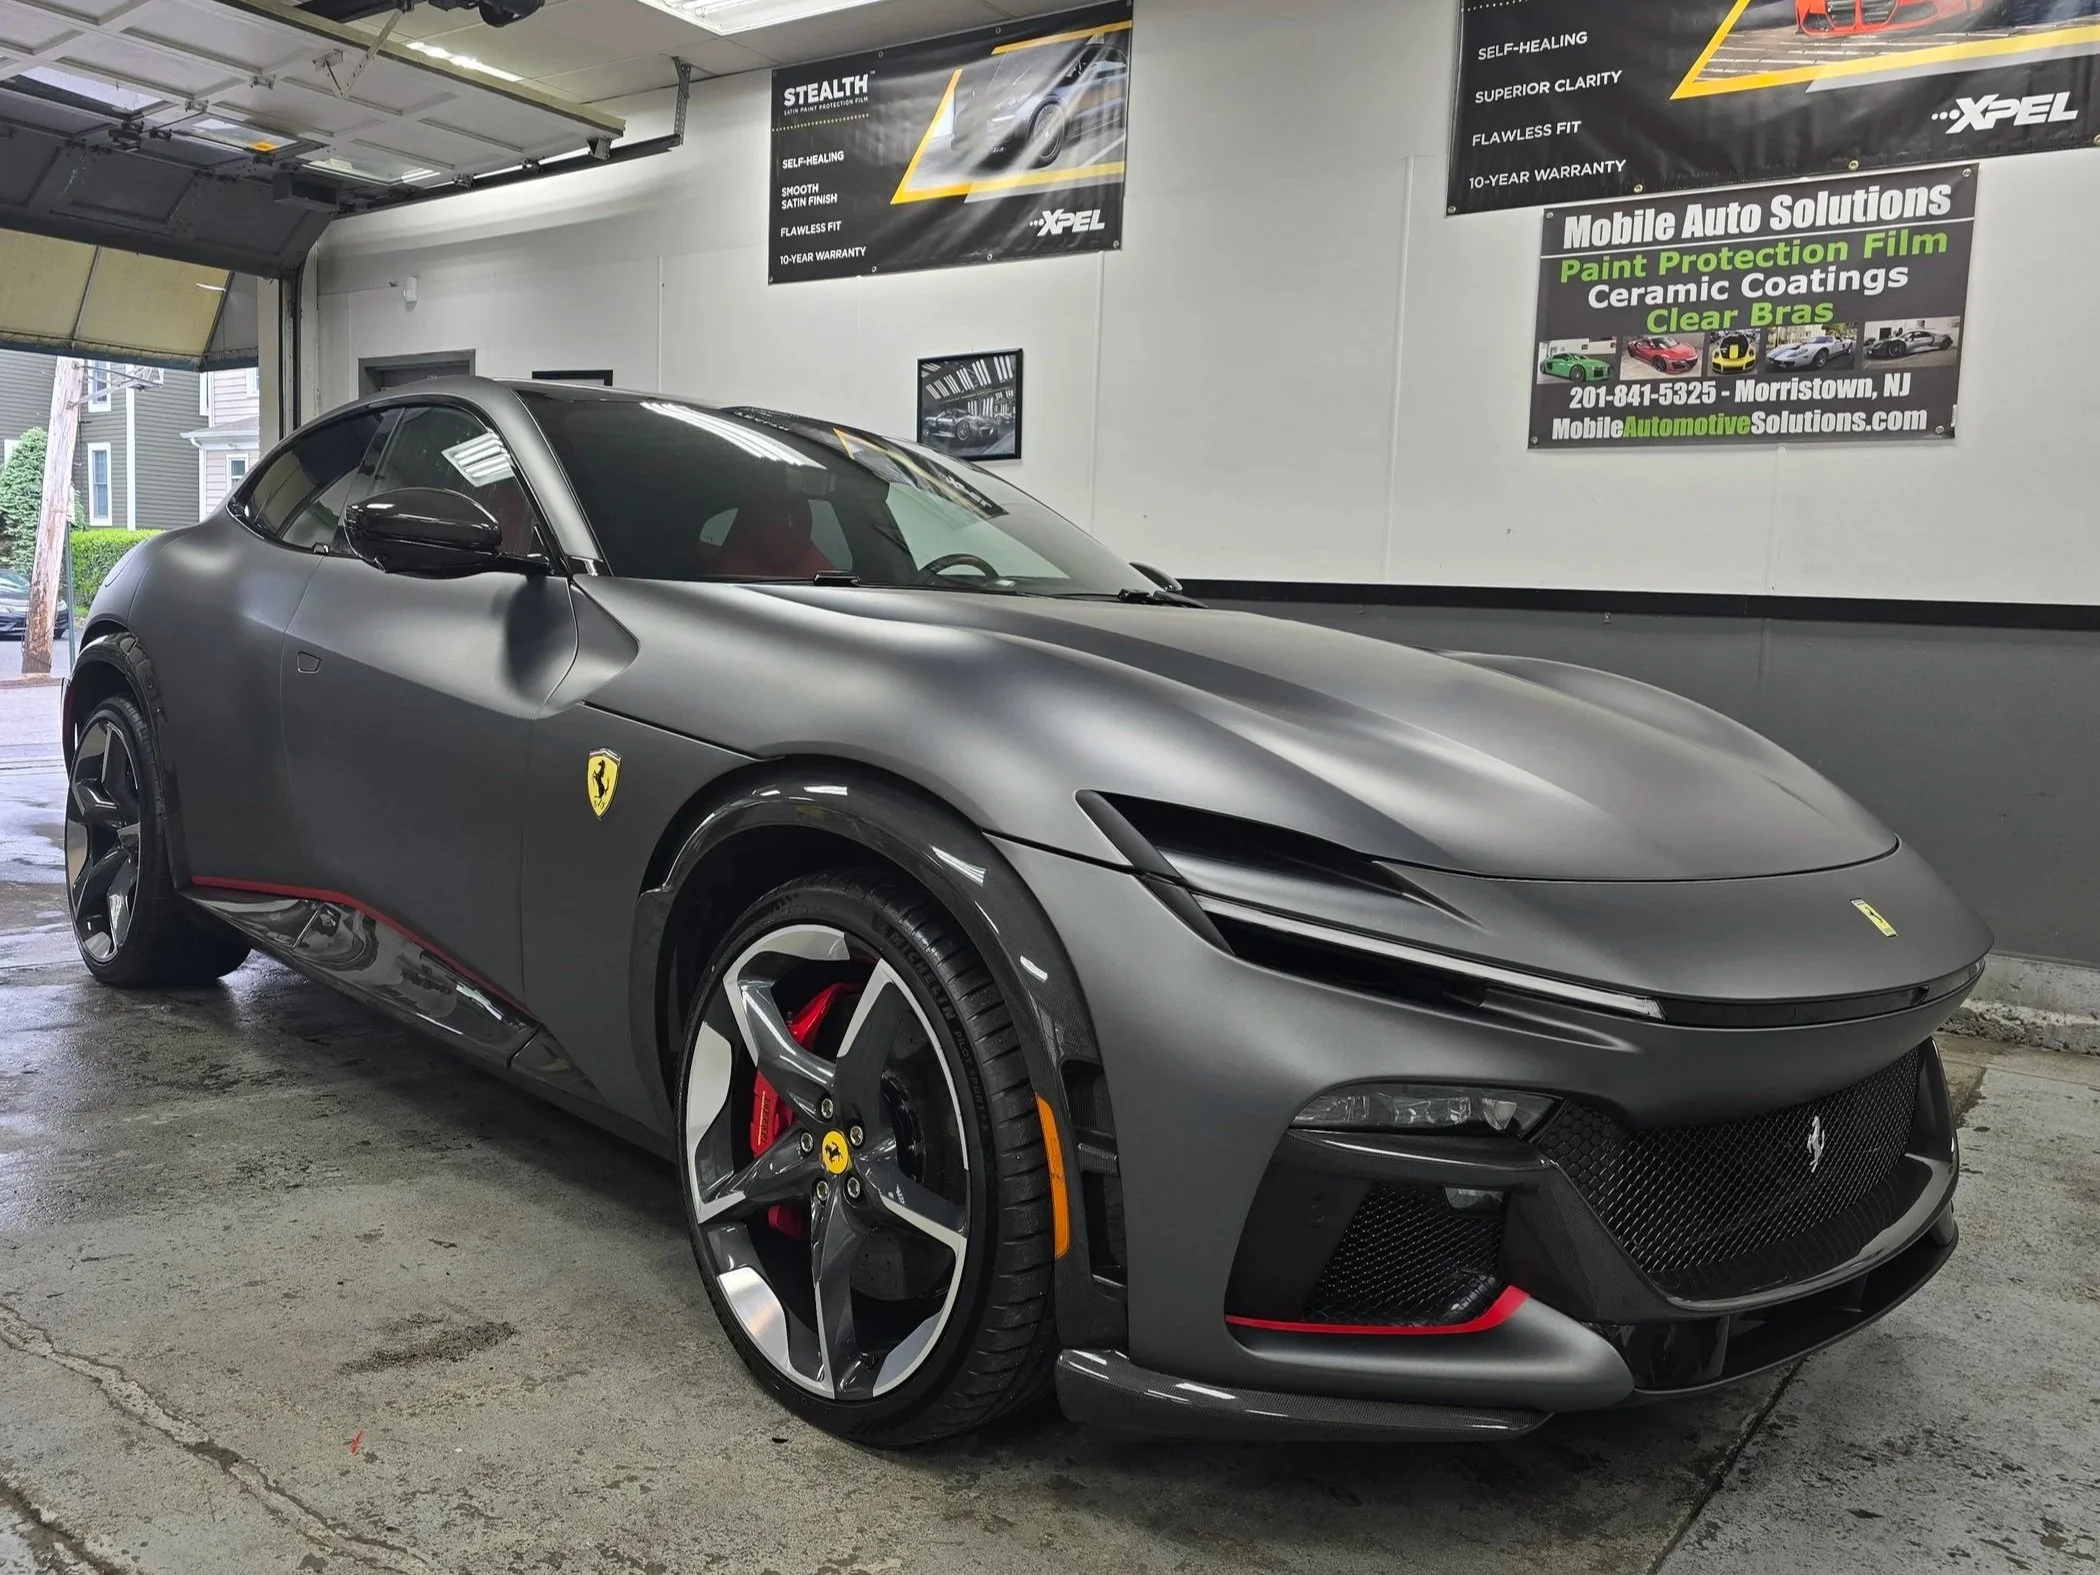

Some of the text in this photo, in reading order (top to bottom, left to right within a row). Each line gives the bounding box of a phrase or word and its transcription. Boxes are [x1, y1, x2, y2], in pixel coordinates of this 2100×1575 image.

[1478, 31, 1588, 60] SELF-HEALING
[784, 74, 868, 107] STEALTH
[1475, 69, 1622, 104] SUPERIOR CLARITY
[819, 99, 853, 110] PROTECTION
[1945, 91, 2079, 134] XPEL
[1472, 121, 1582, 147] FLAWLESS FIT
[782, 150, 844, 169] SELF-HEALING
[1469, 159, 1627, 189] 10-YEAR WARRANTY
[781, 183, 819, 197] SMOOTH
[781, 193, 838, 210] SATIN FINISH
[780, 220, 842, 238] FLAWLESS FIT
[1036, 208, 1106, 237] XPEL
[1563, 184, 1952, 249] Mobile Auto Solutions
[780, 246, 867, 265] 10-YEAR WARRANTY
[1560, 228, 1948, 284] Paint Protection Film
[1588, 265, 1909, 309] Ceramic Coatings
[1646, 302, 1834, 333] Clear Bras
[1569, 380, 1716, 409] 201-841-5325
[1734, 376, 1878, 403] Morristown,
[1883, 372, 1912, 398] NJ
[1551, 409, 1928, 440] MobileAutomotiveSolutions.com
[888, 930, 957, 1021] MICHELIN
